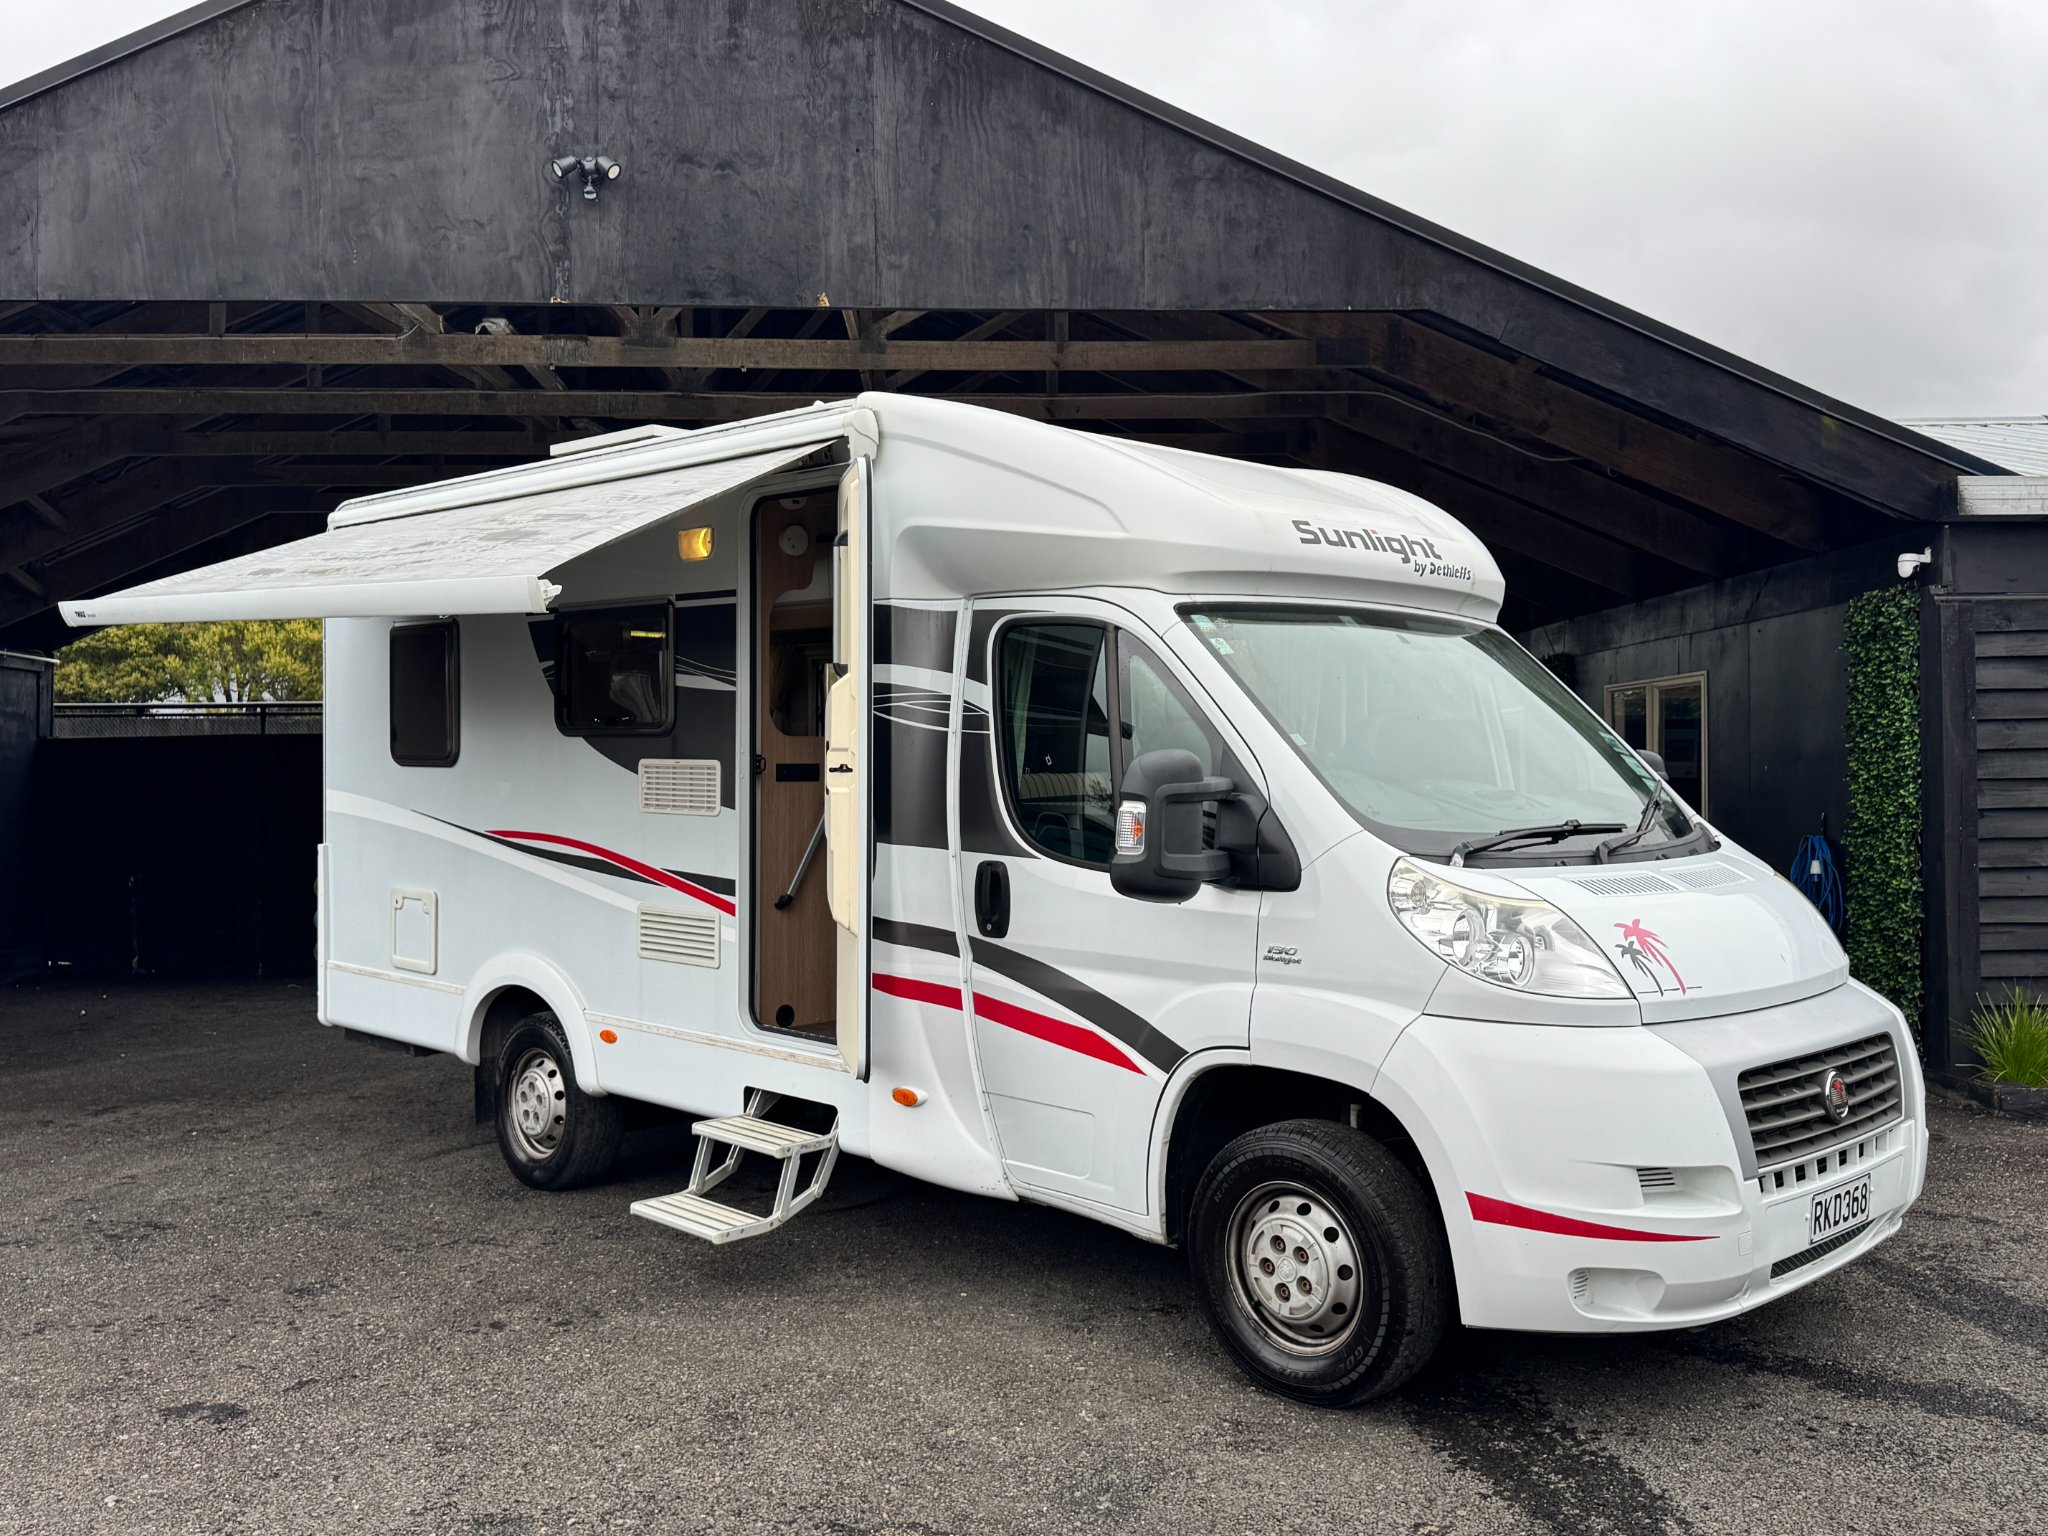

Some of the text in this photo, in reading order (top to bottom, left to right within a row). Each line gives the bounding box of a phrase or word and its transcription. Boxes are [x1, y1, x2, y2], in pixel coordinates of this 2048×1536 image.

[1291, 519, 1443, 564] Sunlight
[1414, 560, 1472, 581] by Dethleffs
[1267, 946, 1298, 956] 130
[1812, 1182, 1868, 1236] RKD368
